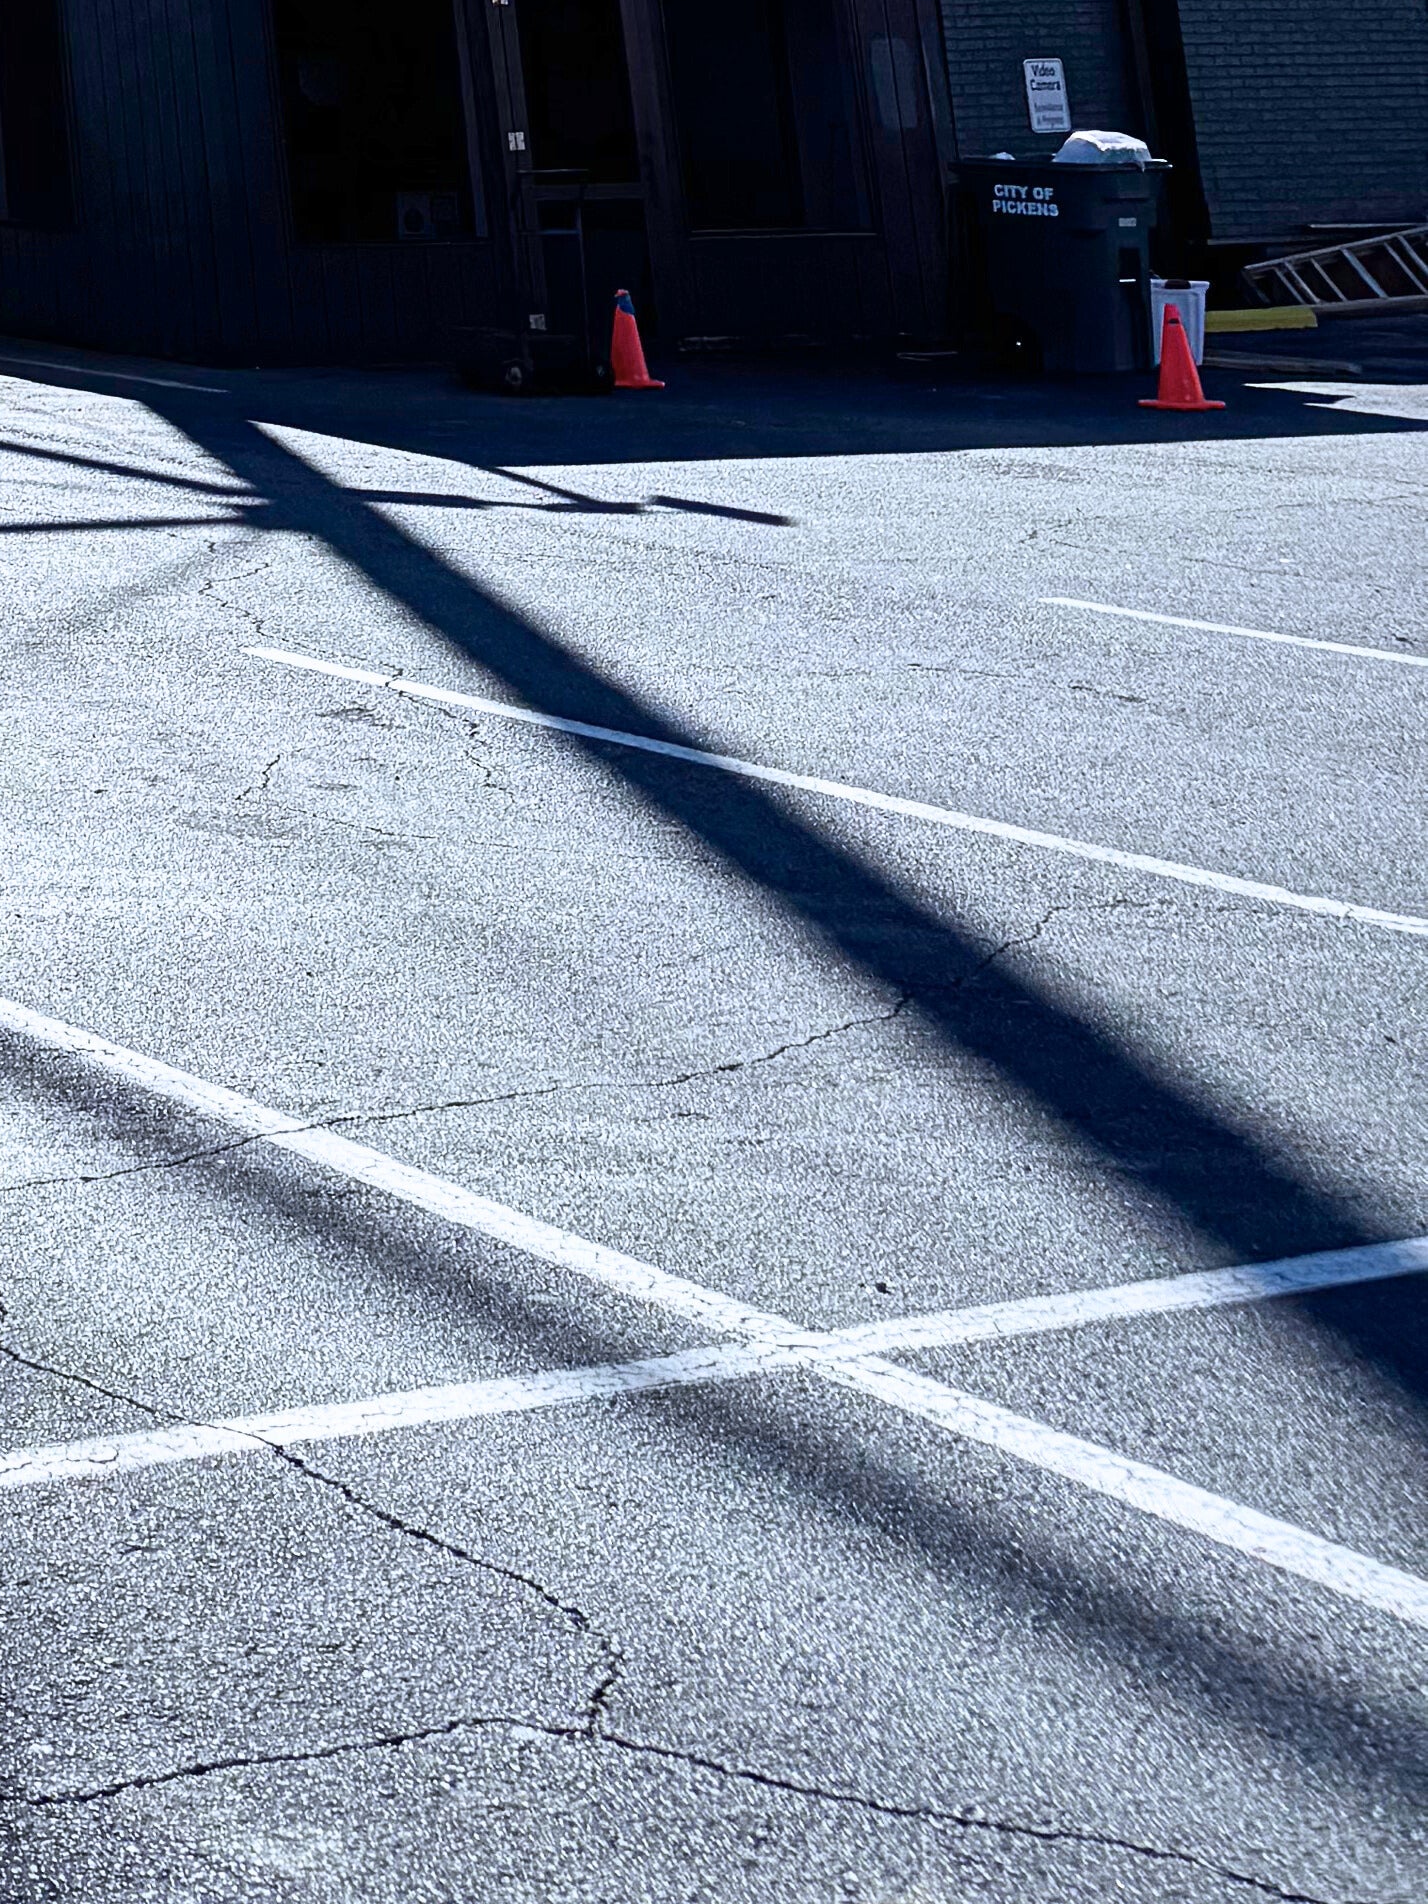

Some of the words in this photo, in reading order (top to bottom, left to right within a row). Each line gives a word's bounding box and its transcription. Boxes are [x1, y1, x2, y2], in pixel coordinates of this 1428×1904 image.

[993, 183, 1029, 199] CITY
[1032, 186, 1055, 201] OF
[991, 199, 1060, 218] PICKENS
